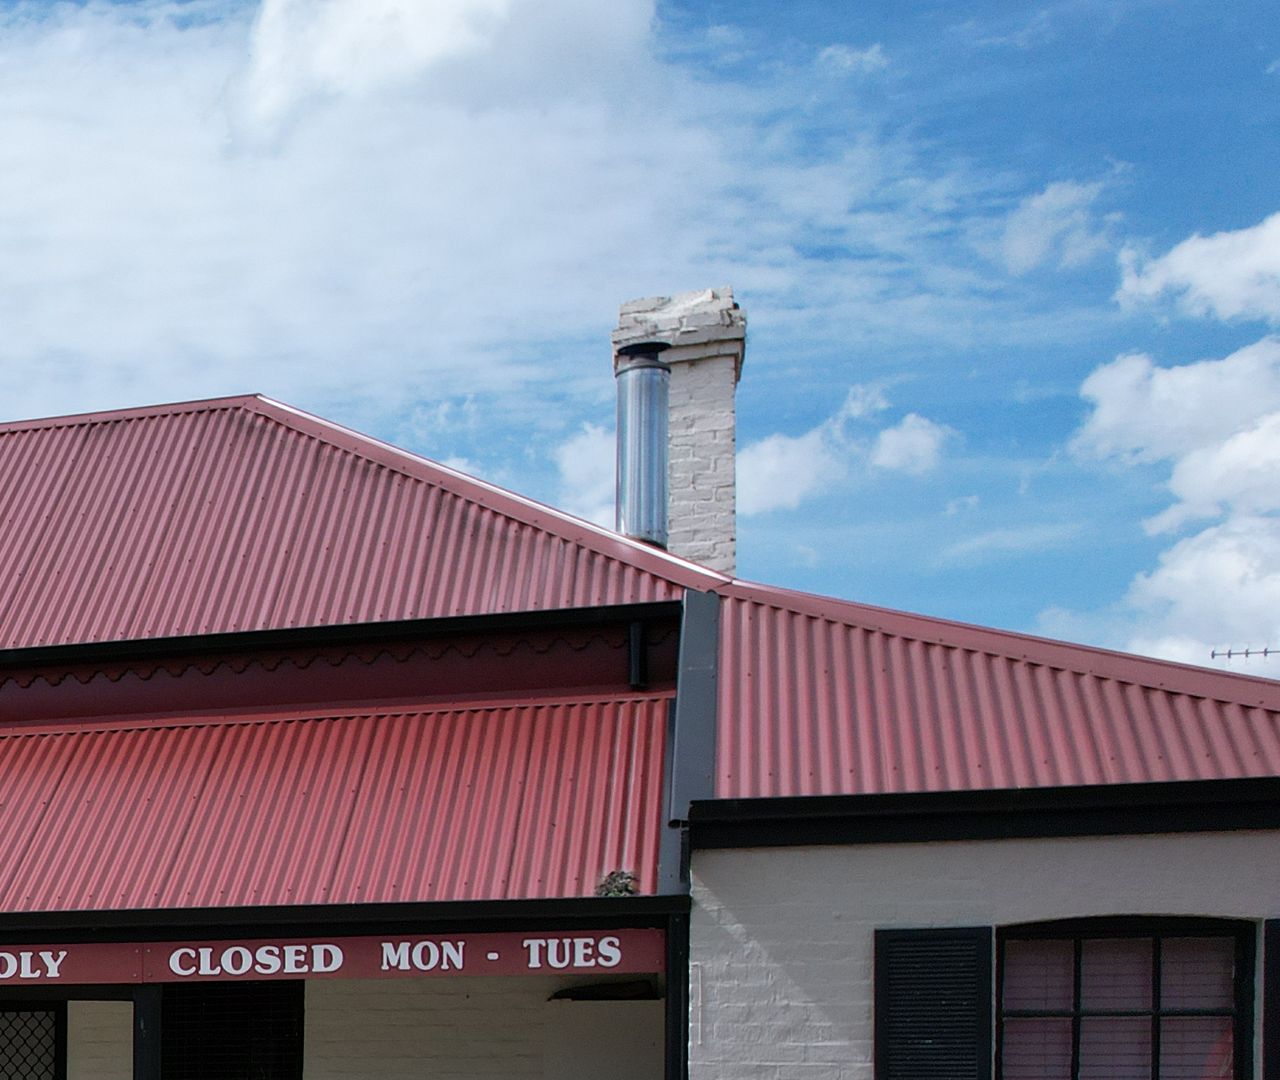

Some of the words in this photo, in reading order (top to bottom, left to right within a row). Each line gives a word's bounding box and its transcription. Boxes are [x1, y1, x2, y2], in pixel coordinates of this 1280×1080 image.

[168, 943, 344, 976] CLOSED
[381, 940, 466, 971] MON
[486, 952, 500, 961] -
[522, 936, 622, 969] TUES
